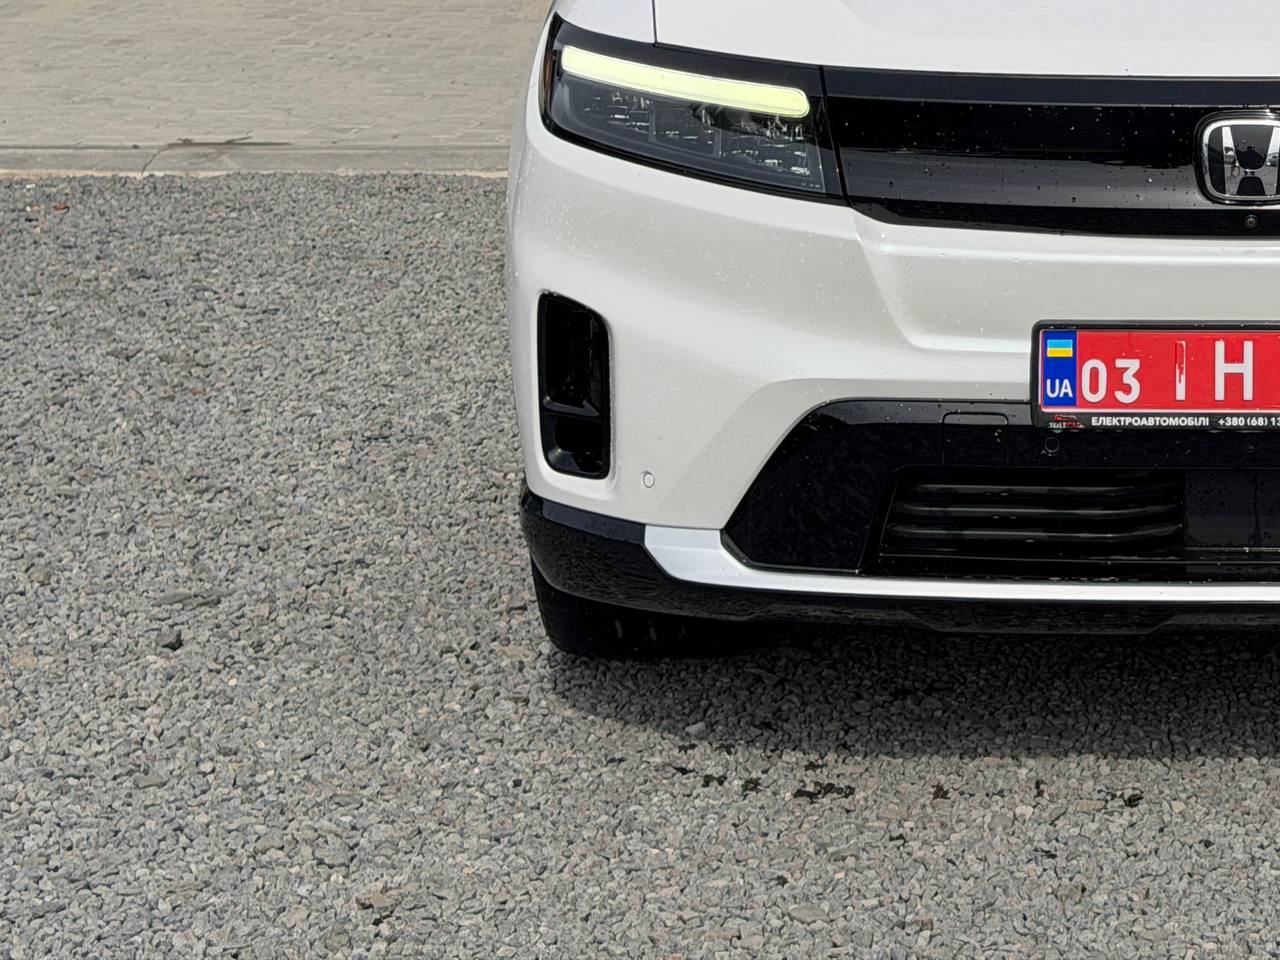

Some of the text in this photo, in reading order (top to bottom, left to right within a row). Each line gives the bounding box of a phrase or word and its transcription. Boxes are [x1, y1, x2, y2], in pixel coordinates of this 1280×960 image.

[1046, 378, 1073, 398] UA
[1081, 358, 1141, 404] 03
[1091, 416, 1209, 426] ЕЛЕКТРОАВТОМОБІЛІ
[1218, 416, 1244, 426] +380
[1247, 416, 1268, 427] (68)
